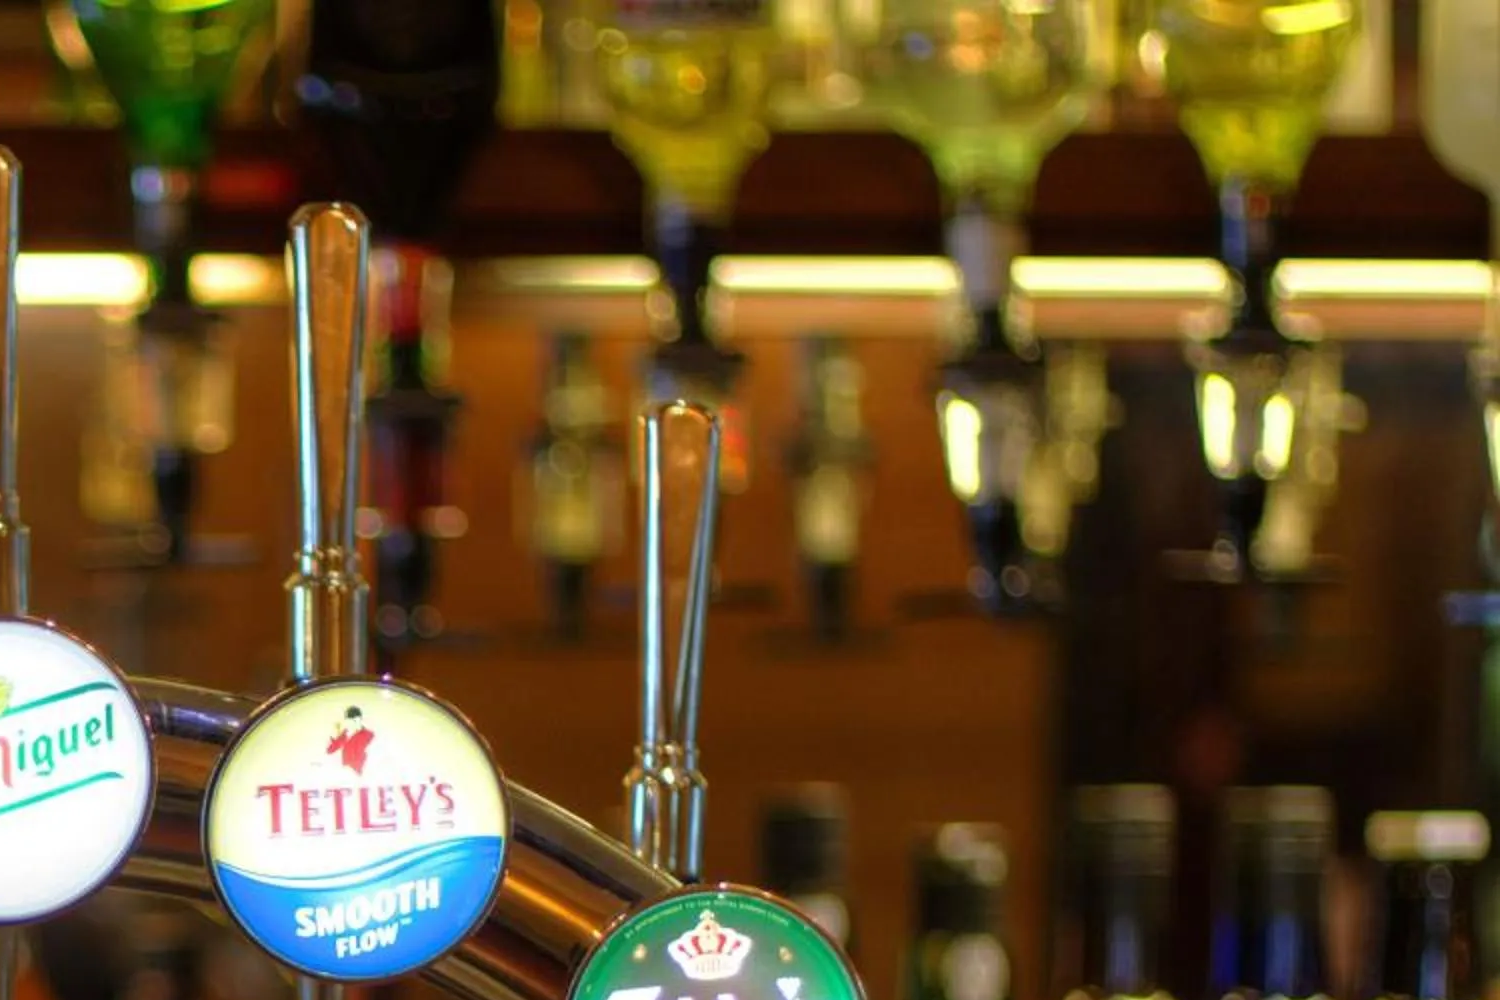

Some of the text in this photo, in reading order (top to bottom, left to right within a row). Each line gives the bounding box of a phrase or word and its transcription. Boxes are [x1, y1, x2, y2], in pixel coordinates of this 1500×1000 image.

[255, 775, 456, 839] TETLEY'S
[295, 876, 441, 938] SMOOTH
[335, 922, 399, 959] FLOW
